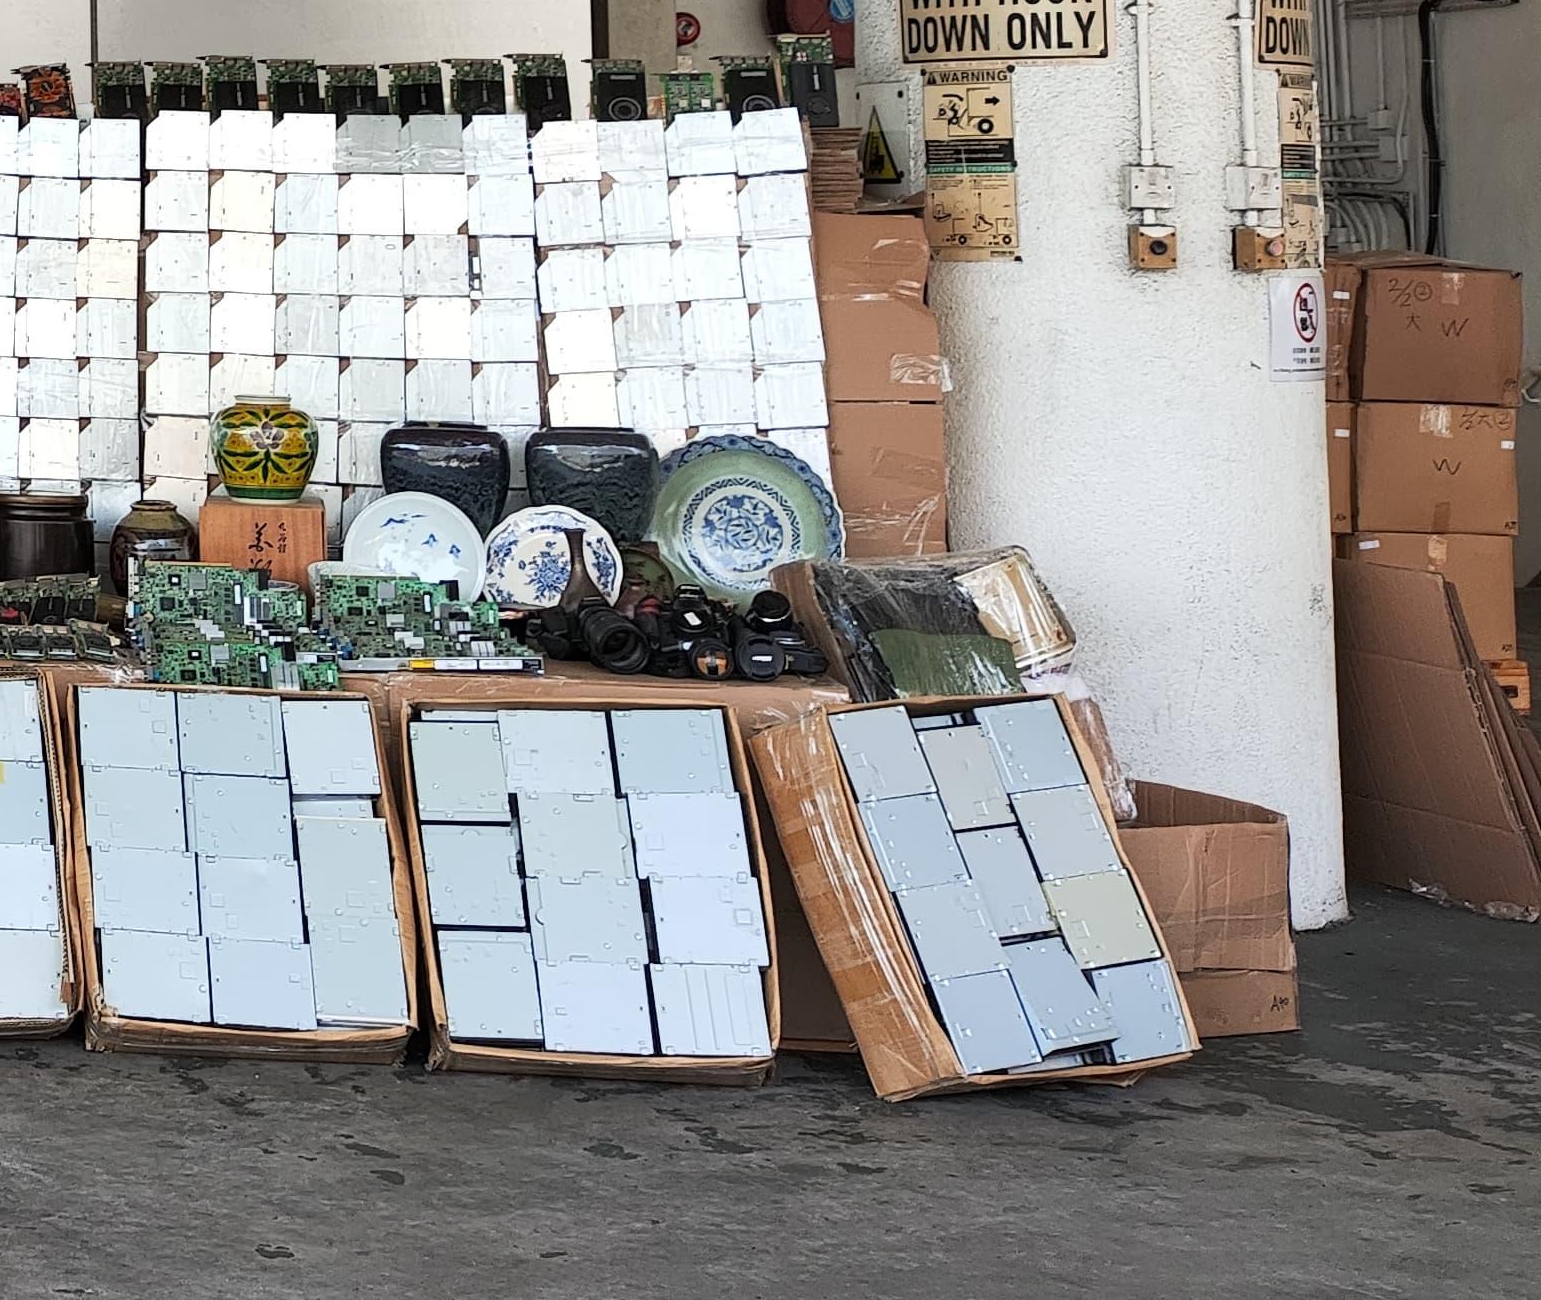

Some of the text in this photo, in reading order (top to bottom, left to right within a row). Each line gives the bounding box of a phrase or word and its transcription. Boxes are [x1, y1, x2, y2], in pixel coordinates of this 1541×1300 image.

[908, 10, 1096, 54] DOWN ONLY
[939, 70, 1008, 83] WARNING
[1441, 317, 1469, 337] W
